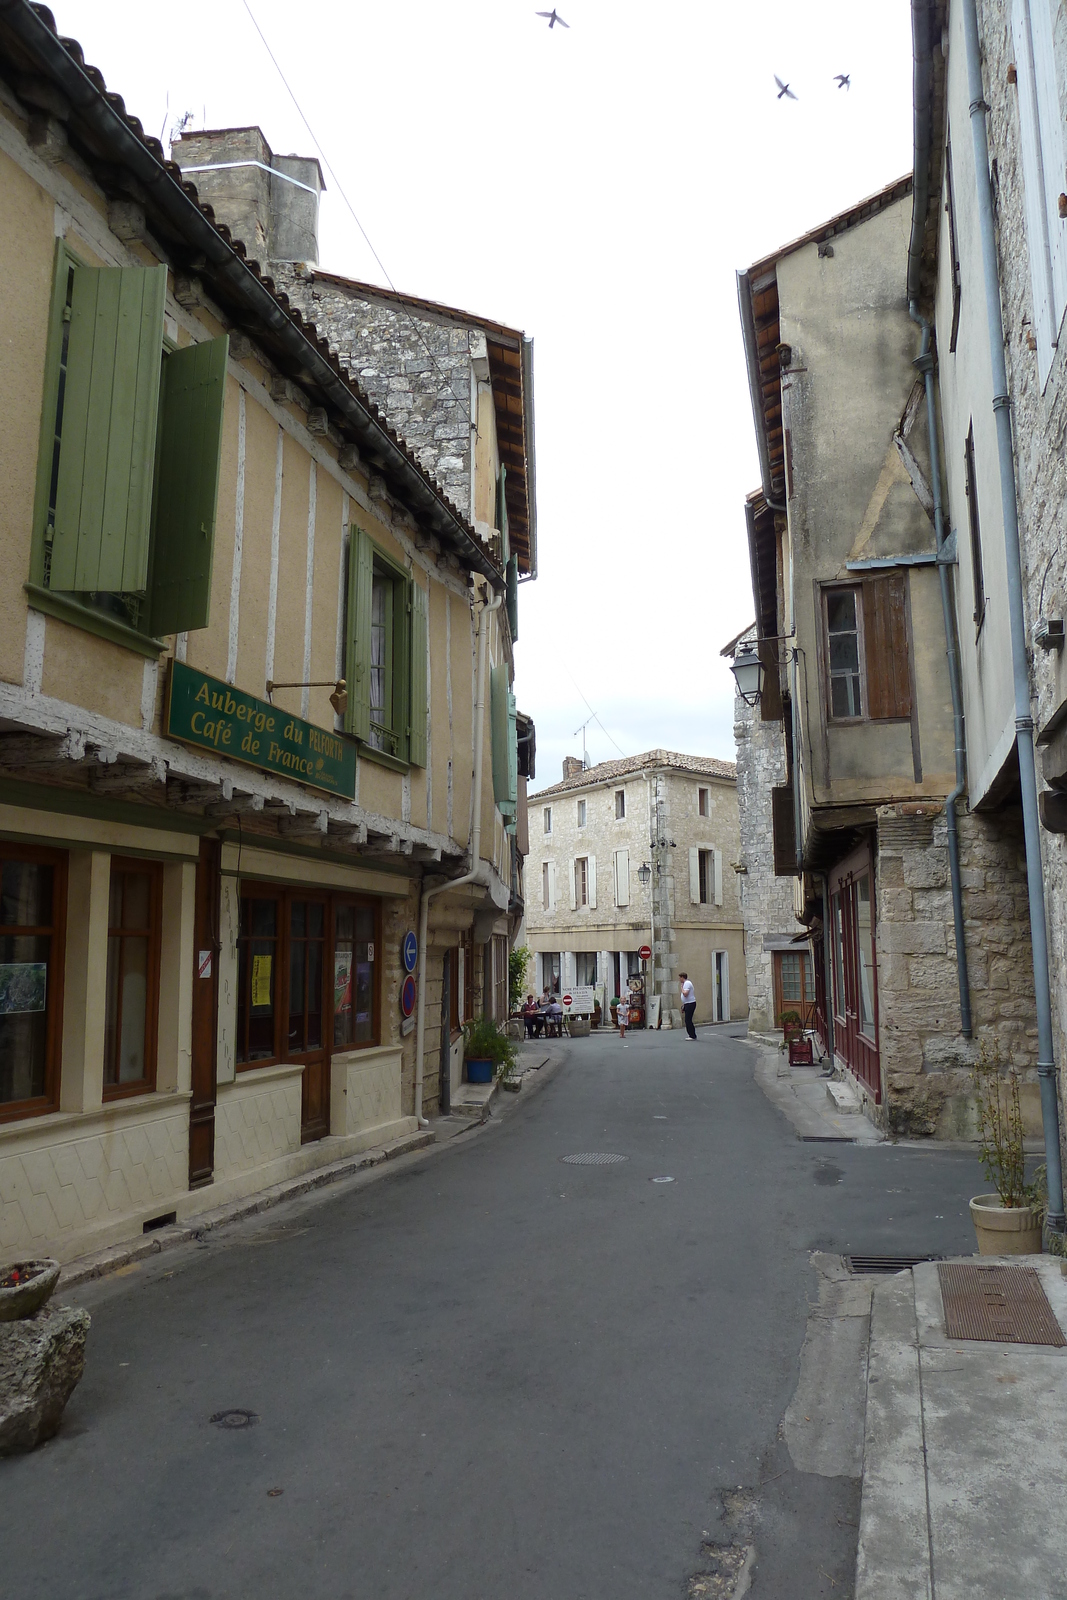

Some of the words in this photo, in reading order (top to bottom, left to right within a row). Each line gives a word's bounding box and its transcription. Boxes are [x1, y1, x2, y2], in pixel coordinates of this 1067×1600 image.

[191, 711, 232, 746] Café
[241, 731, 260, 755] de
[268, 741, 313, 775] France
[195, 682, 275, 732] Auberge
[284, 720, 303, 745] du
[309, 728, 343, 762] PELFORTH
